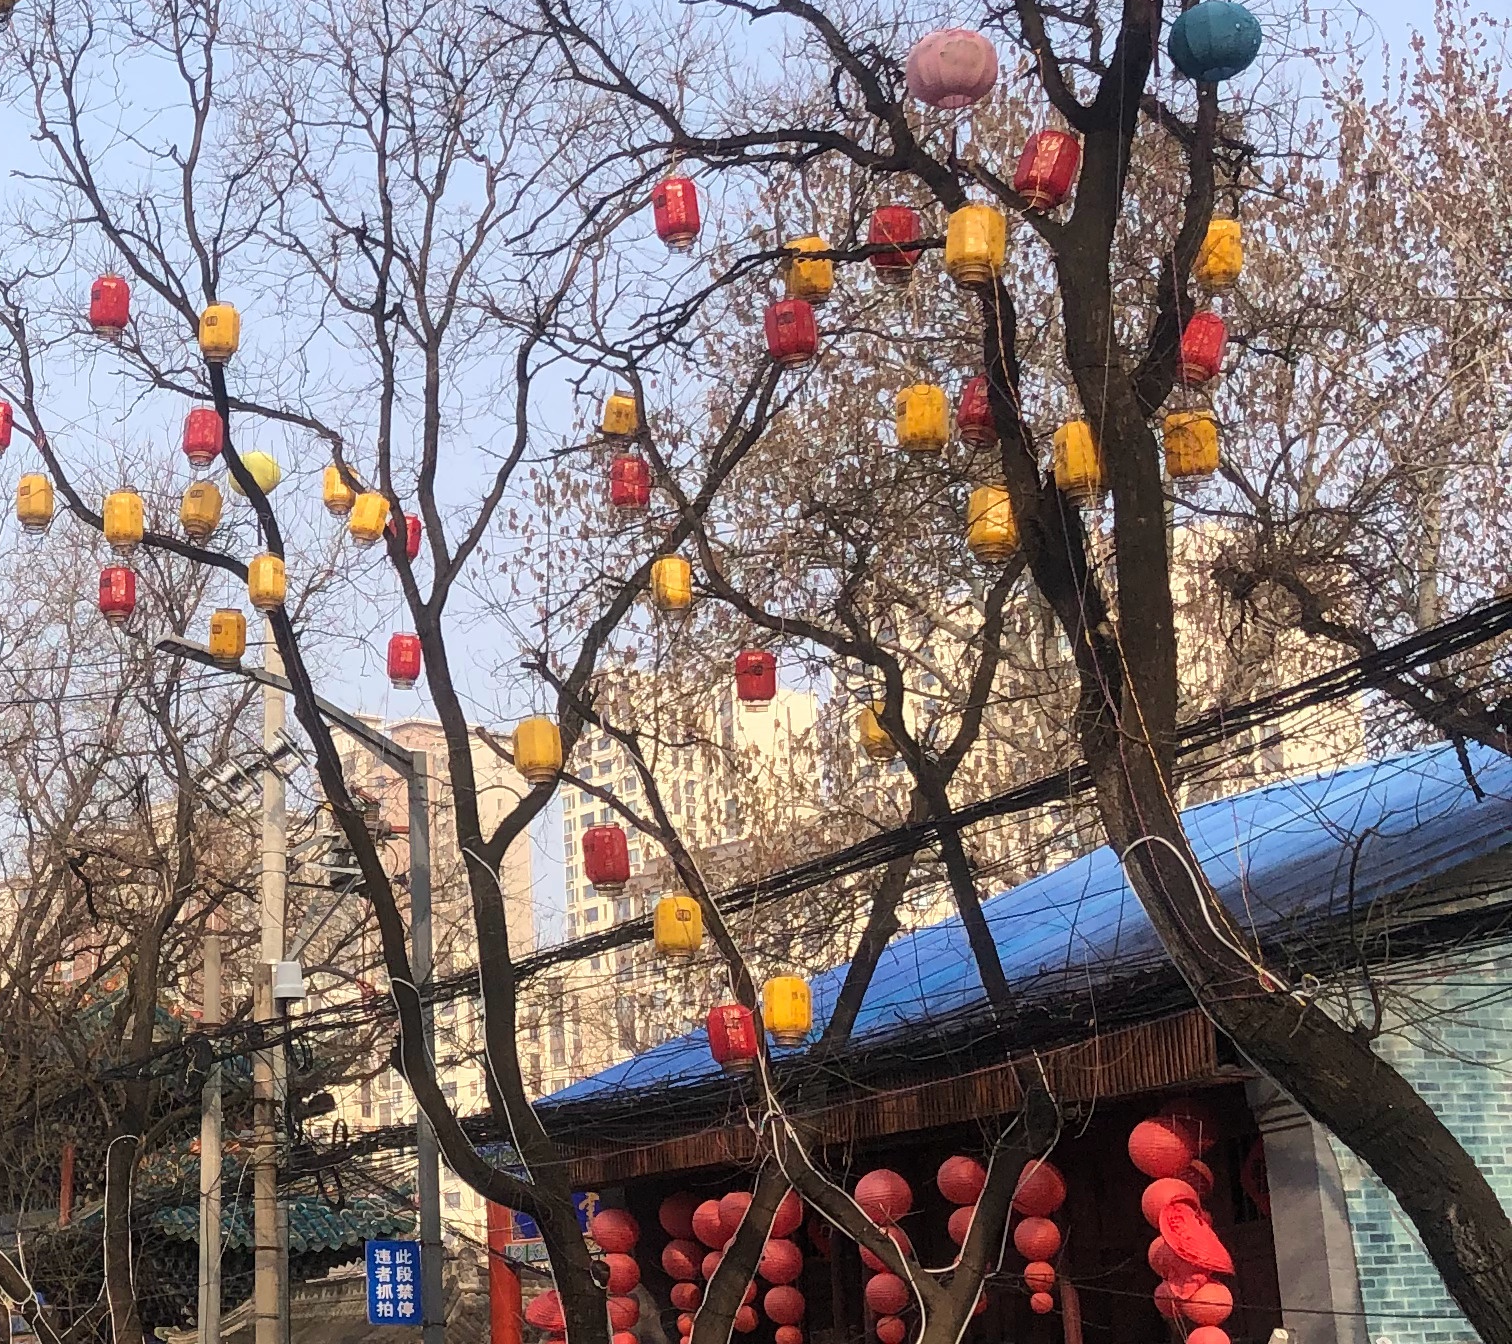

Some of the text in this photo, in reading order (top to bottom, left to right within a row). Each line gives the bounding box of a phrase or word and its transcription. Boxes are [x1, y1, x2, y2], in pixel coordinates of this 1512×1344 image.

[374, 1248, 394, 1318] 违者抓拍
[395, 1248, 415, 1318] 此段禁停
